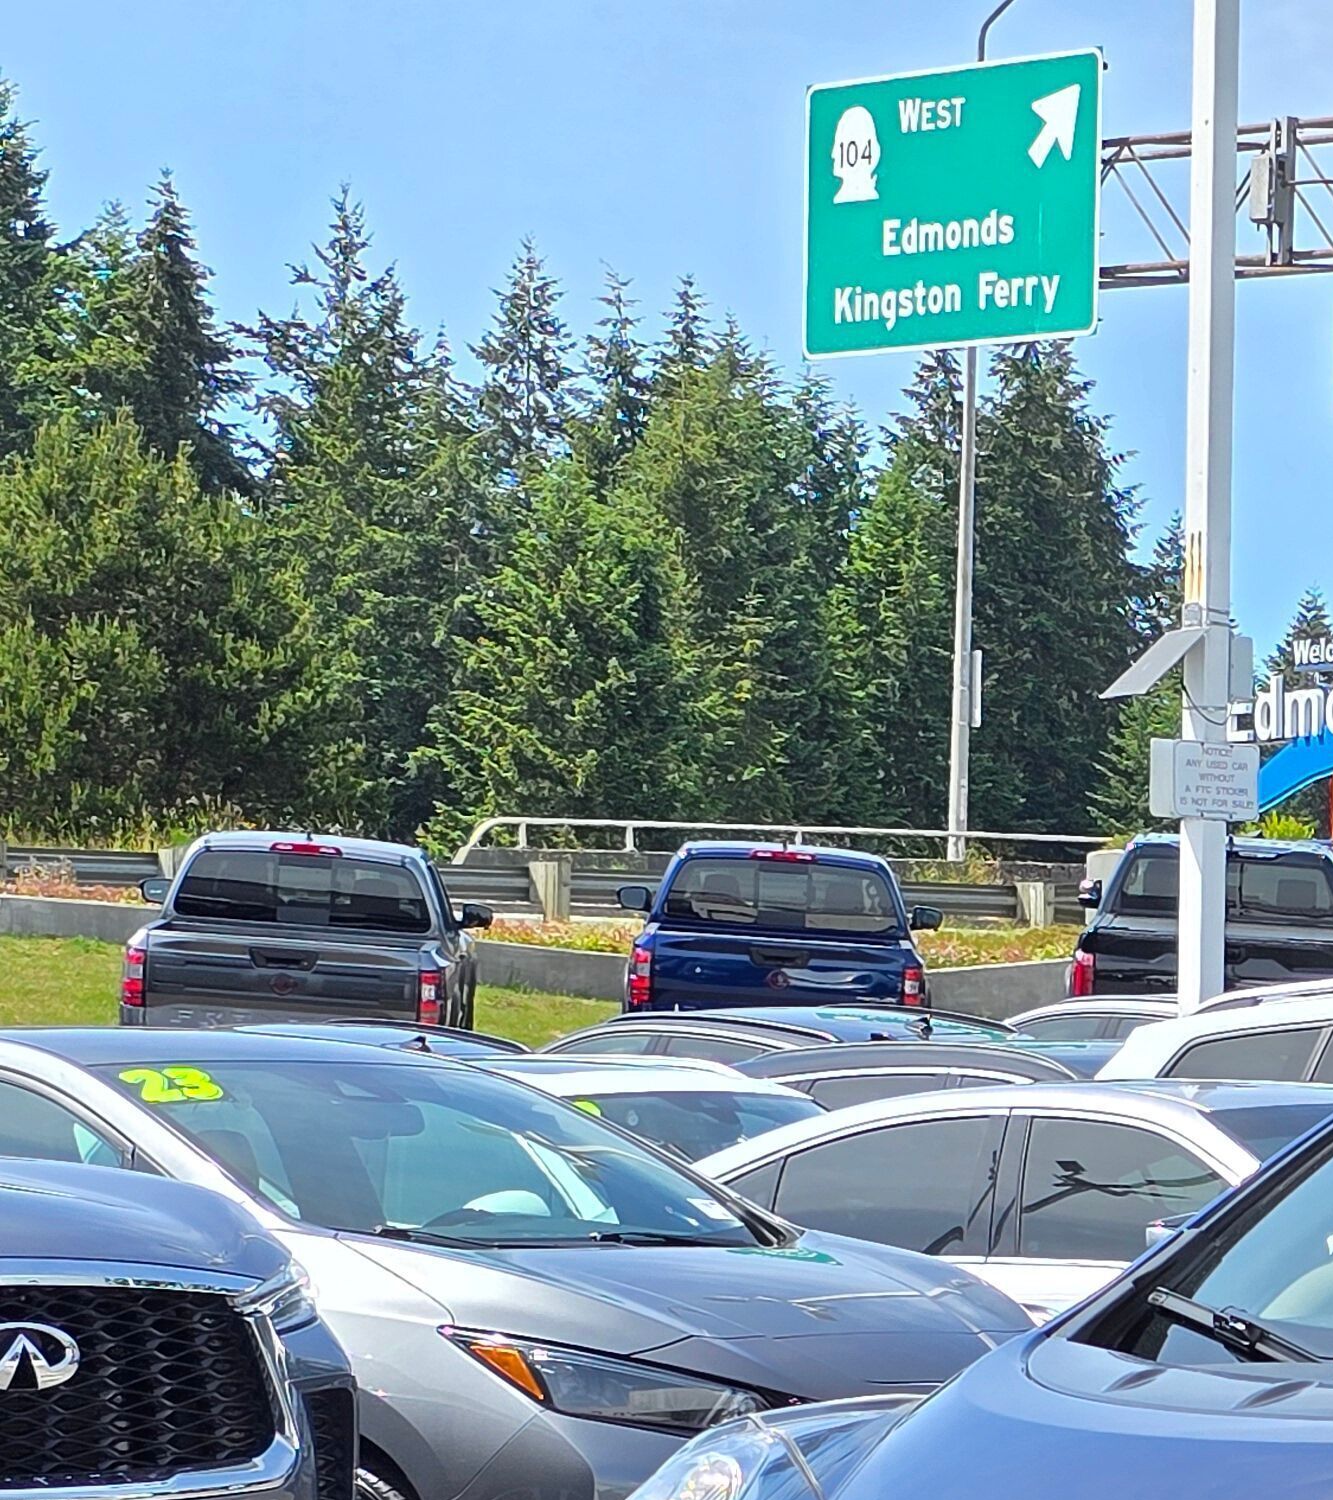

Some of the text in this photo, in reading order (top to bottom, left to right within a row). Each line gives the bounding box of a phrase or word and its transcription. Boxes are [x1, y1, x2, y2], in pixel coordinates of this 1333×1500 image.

[898, 97, 966, 135] WEST
[838, 139, 872, 169] 104
[882, 208, 1015, 257] Edmonds
[834, 271, 1061, 330] Kingston Ferry
[118, 1065, 224, 1103] 23
